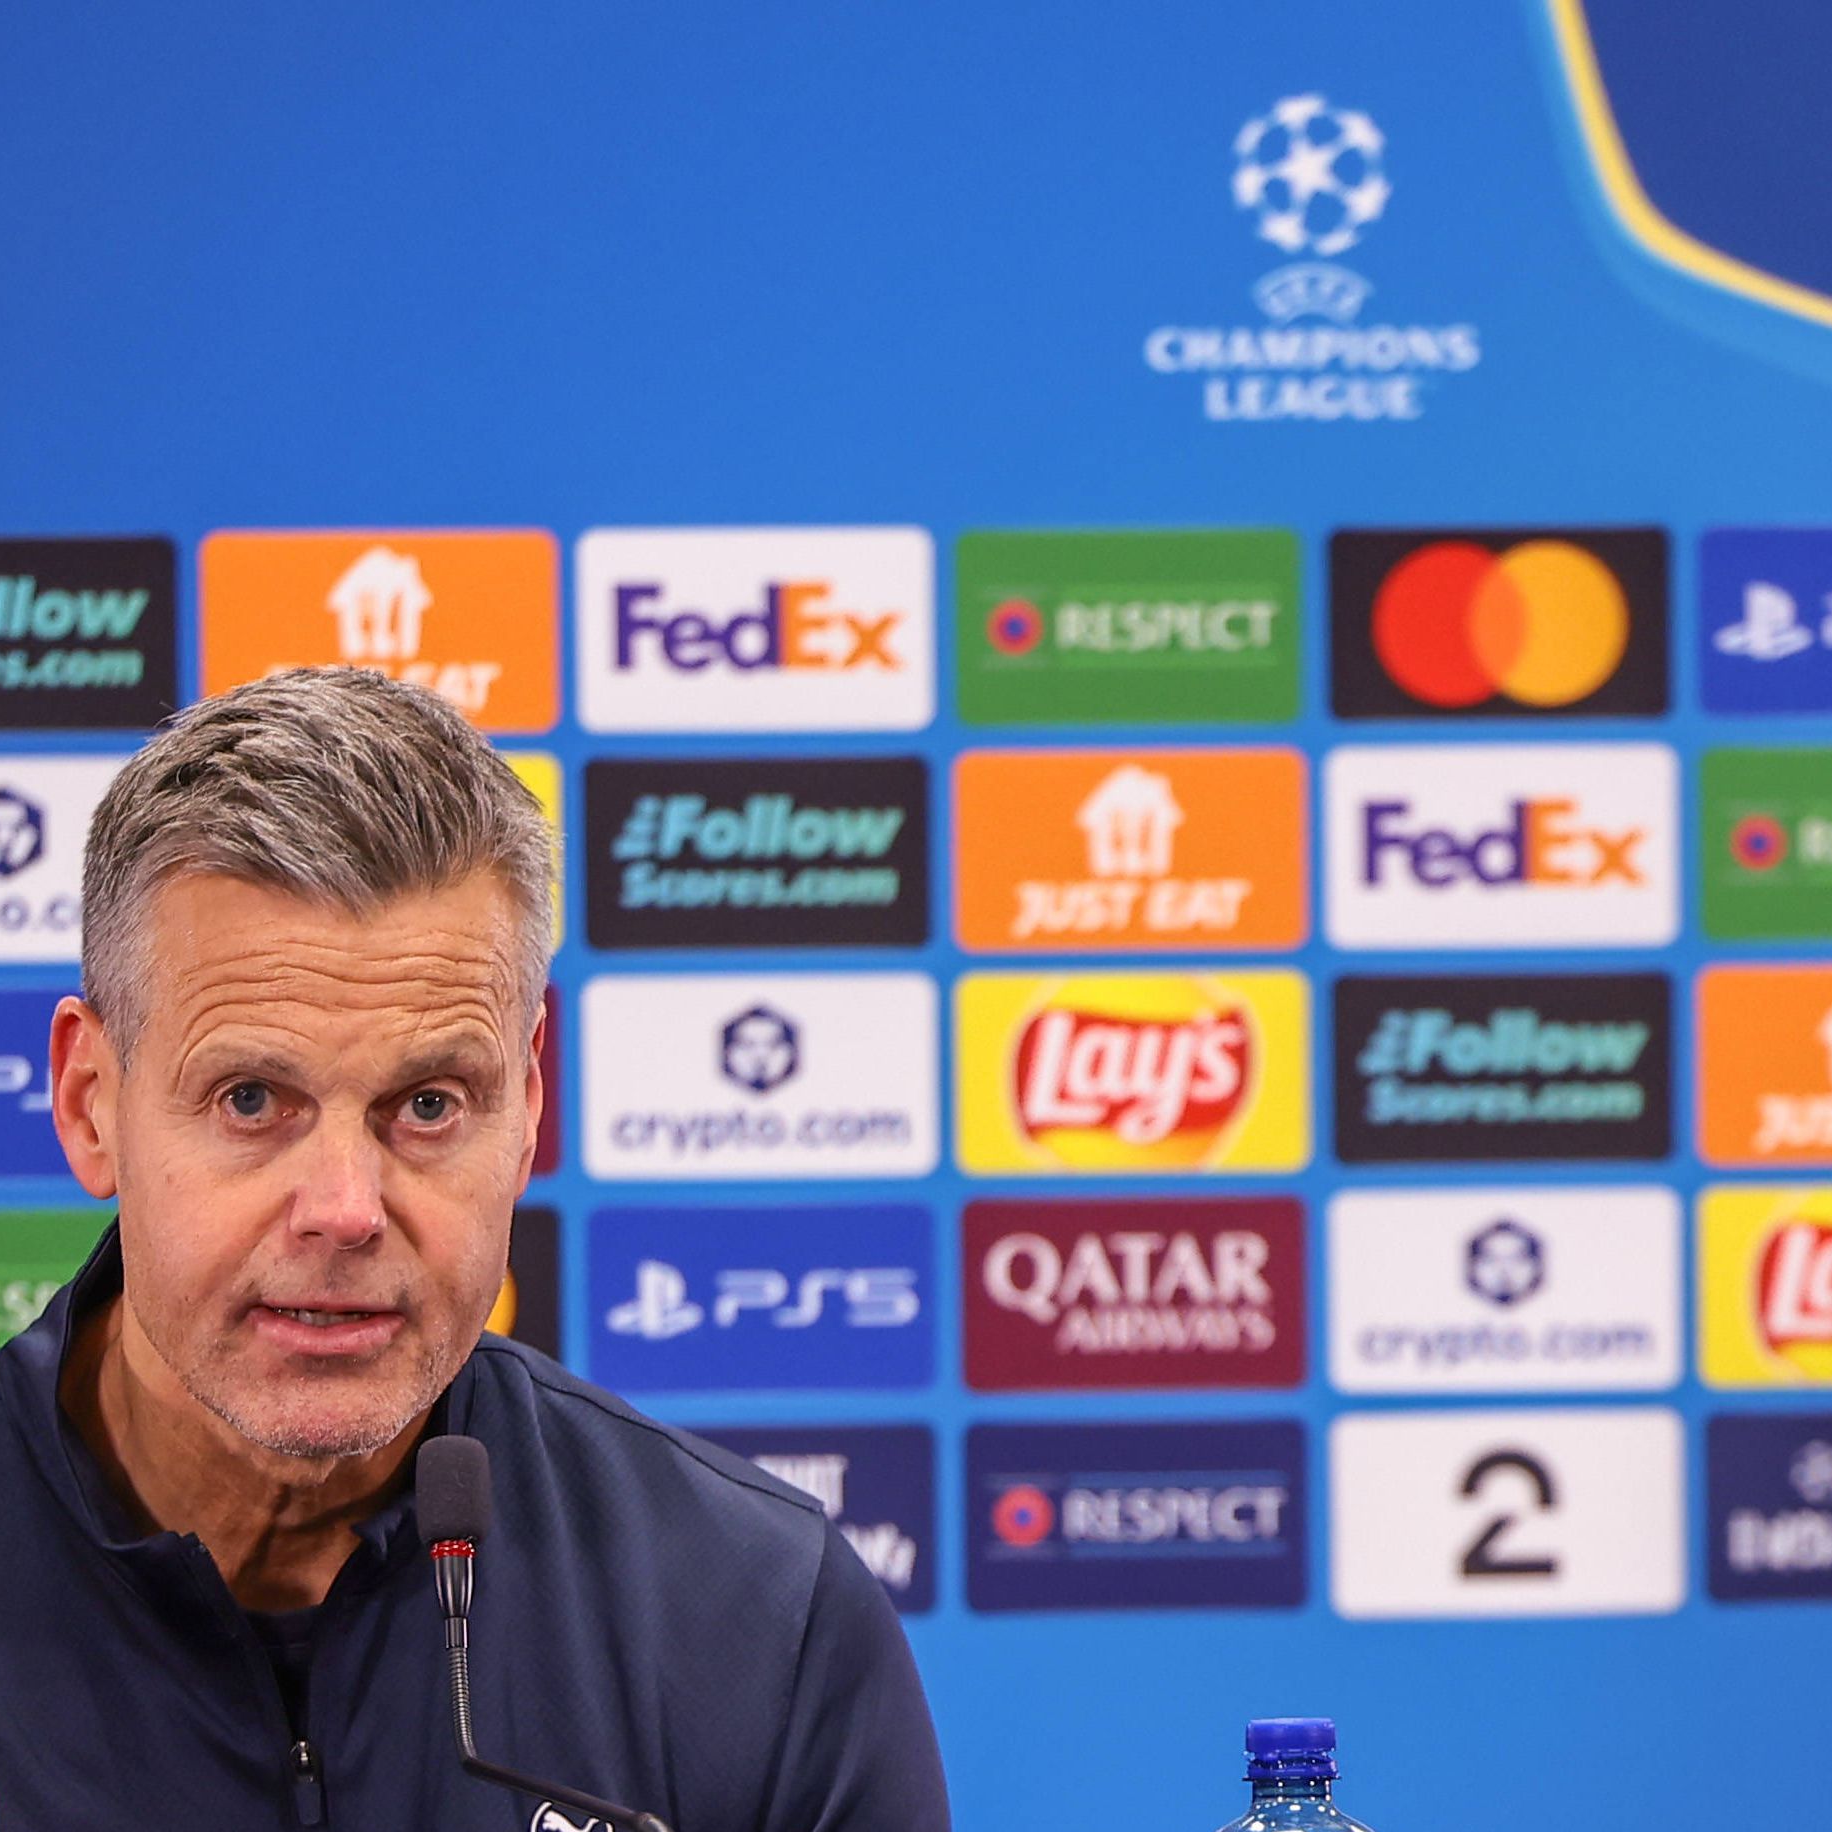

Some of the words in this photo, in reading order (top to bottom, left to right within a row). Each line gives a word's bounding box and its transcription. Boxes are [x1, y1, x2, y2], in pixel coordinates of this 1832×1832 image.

[1144, 325, 1480, 373] CHAMPIONS
[1205, 375, 1423, 421] LEAGUE
[613, 580, 904, 673] FedEx
[1055, 602, 1277, 652] RESPECT
[1359, 798, 1645, 888] FedEx
[620, 863, 900, 910] Scores.com
[1010, 881, 1137, 938] JUST
[1145, 879, 1249, 930] EAT
[1026, 1009, 1244, 1142] Lay's
[611, 1108, 909, 1154] crypto.com
[715, 1269, 919, 1328] PS5
[984, 1232, 1272, 1321] QATAR
[1063, 1487, 1287, 1541] RESPECT
[1459, 1449, 1557, 1580] 2
